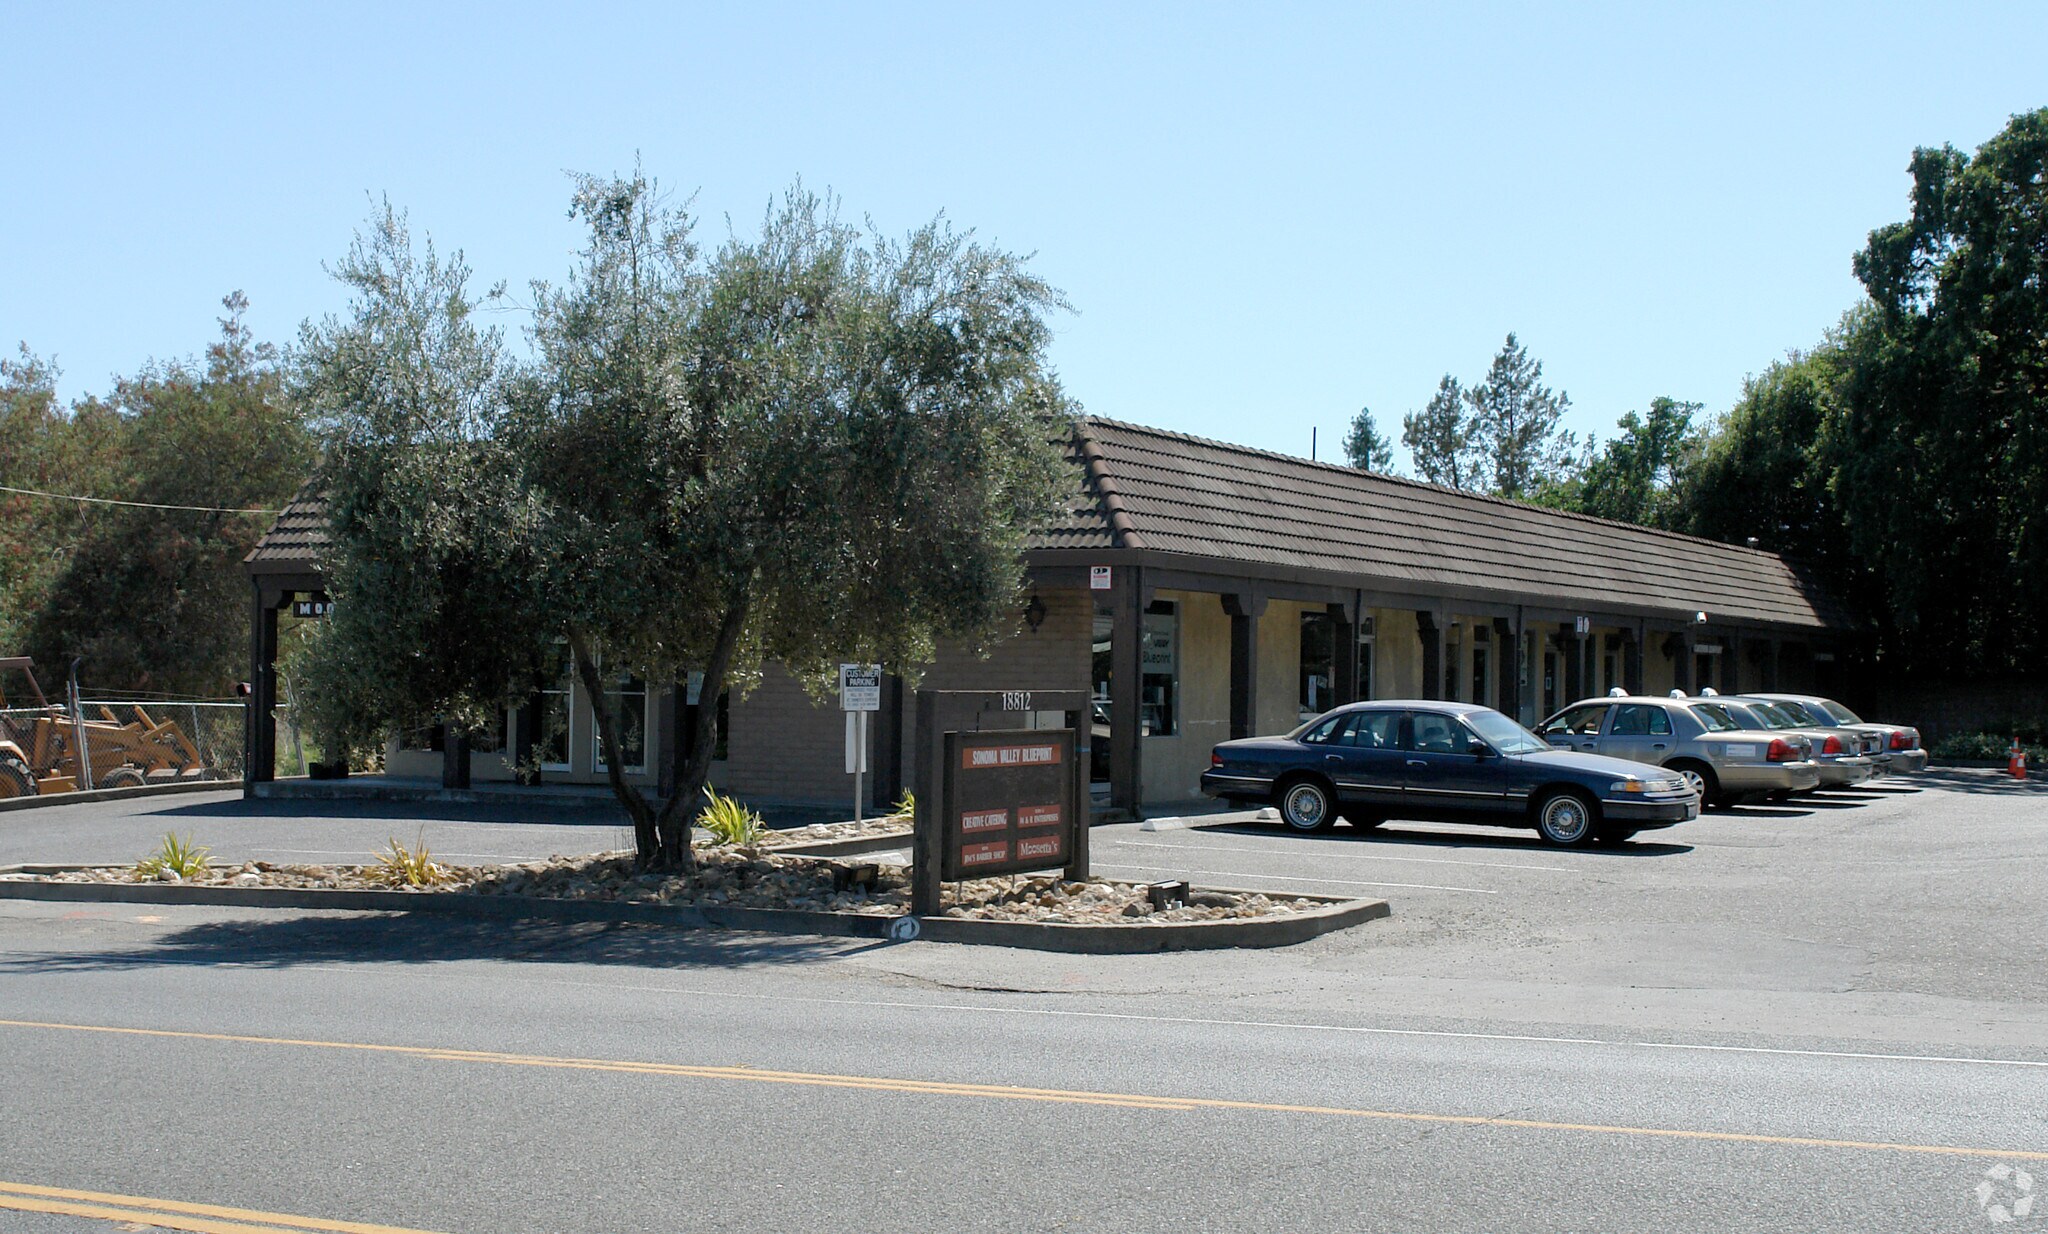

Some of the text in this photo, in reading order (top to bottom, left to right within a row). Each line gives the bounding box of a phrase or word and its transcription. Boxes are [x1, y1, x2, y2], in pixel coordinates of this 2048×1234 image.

[849, 678, 876, 686] PARKING
[1002, 692, 1031, 711] 18812
[972, 747, 1053, 765] SONOMA VALLEY BLUEPRINT
[962, 812, 1007, 829] CREATIVE CATERING
